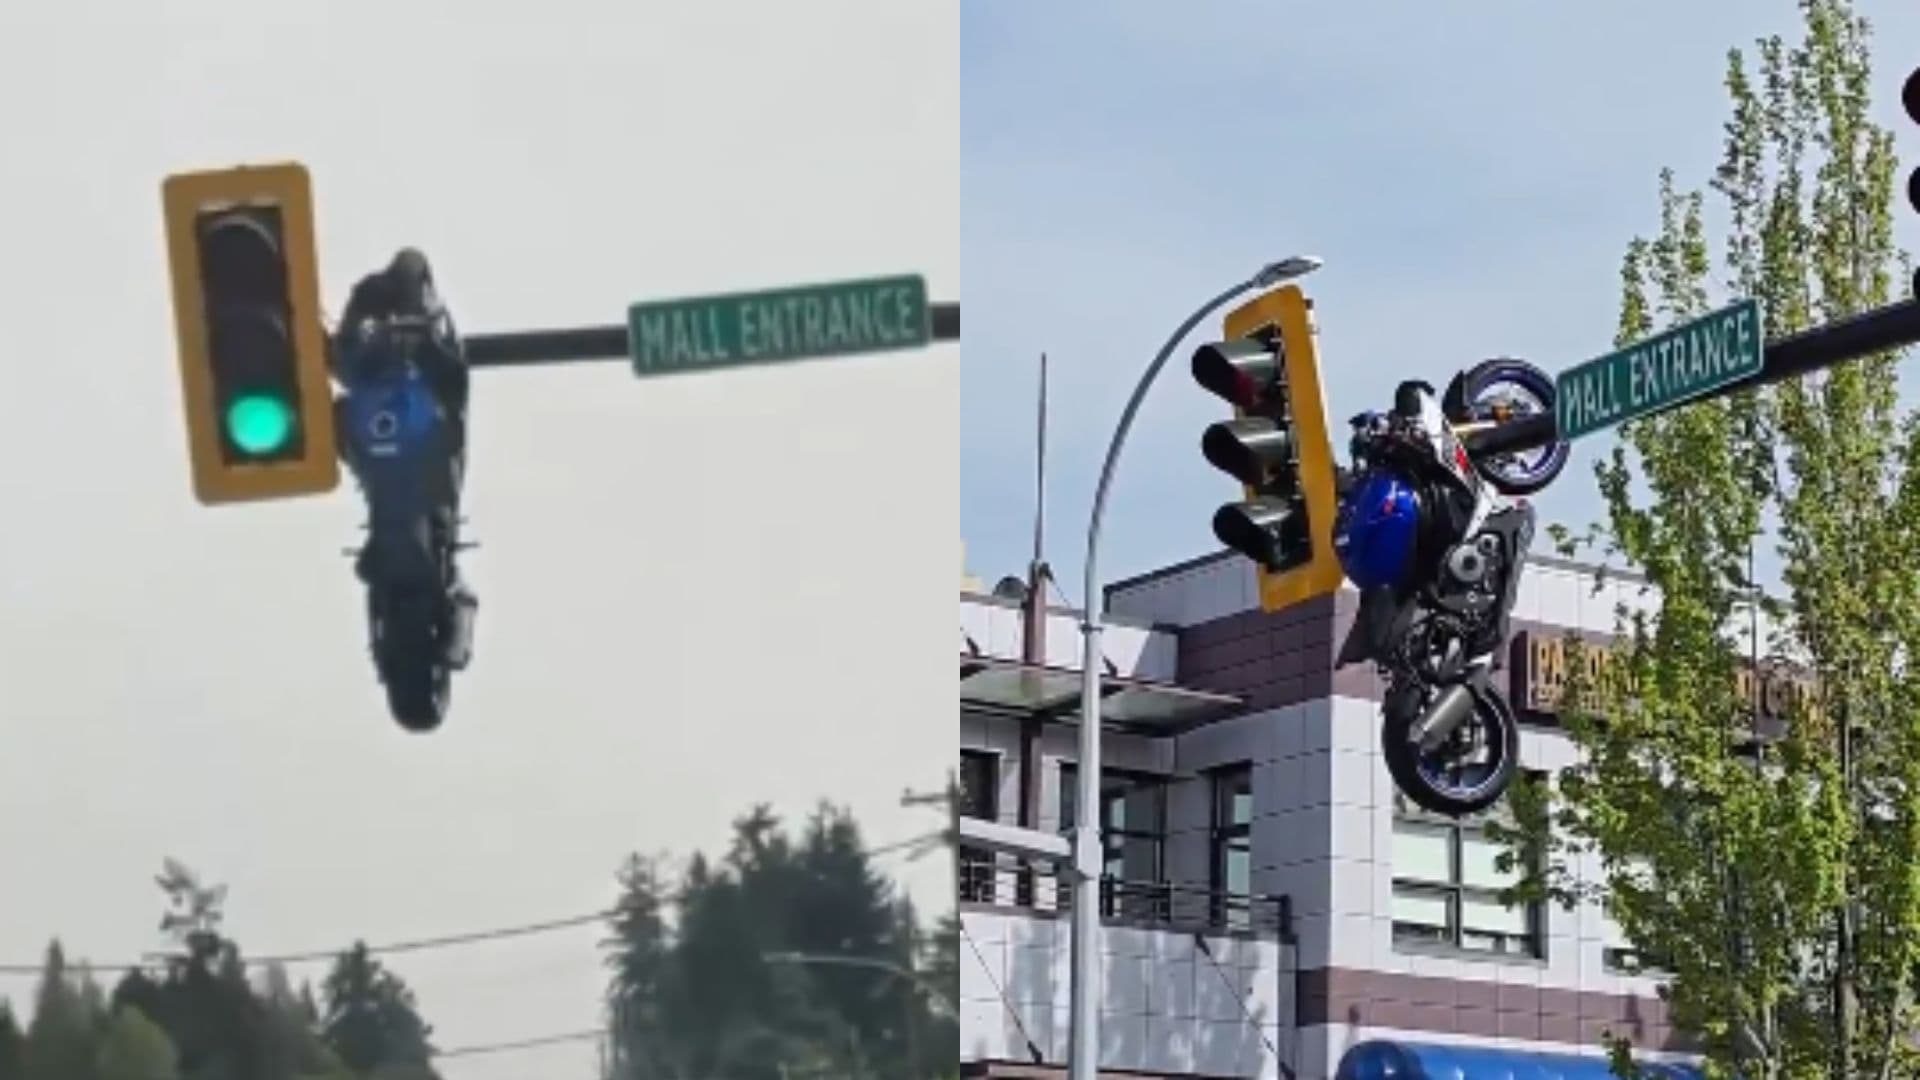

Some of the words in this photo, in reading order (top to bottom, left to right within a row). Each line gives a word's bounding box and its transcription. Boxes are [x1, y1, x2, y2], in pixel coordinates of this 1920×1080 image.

[640, 305, 727, 364] MALL
[739, 286, 915, 355] ENTRANCE
[1564, 362, 1621, 432] MALL
[1630, 309, 1753, 405] ENTRANCE
